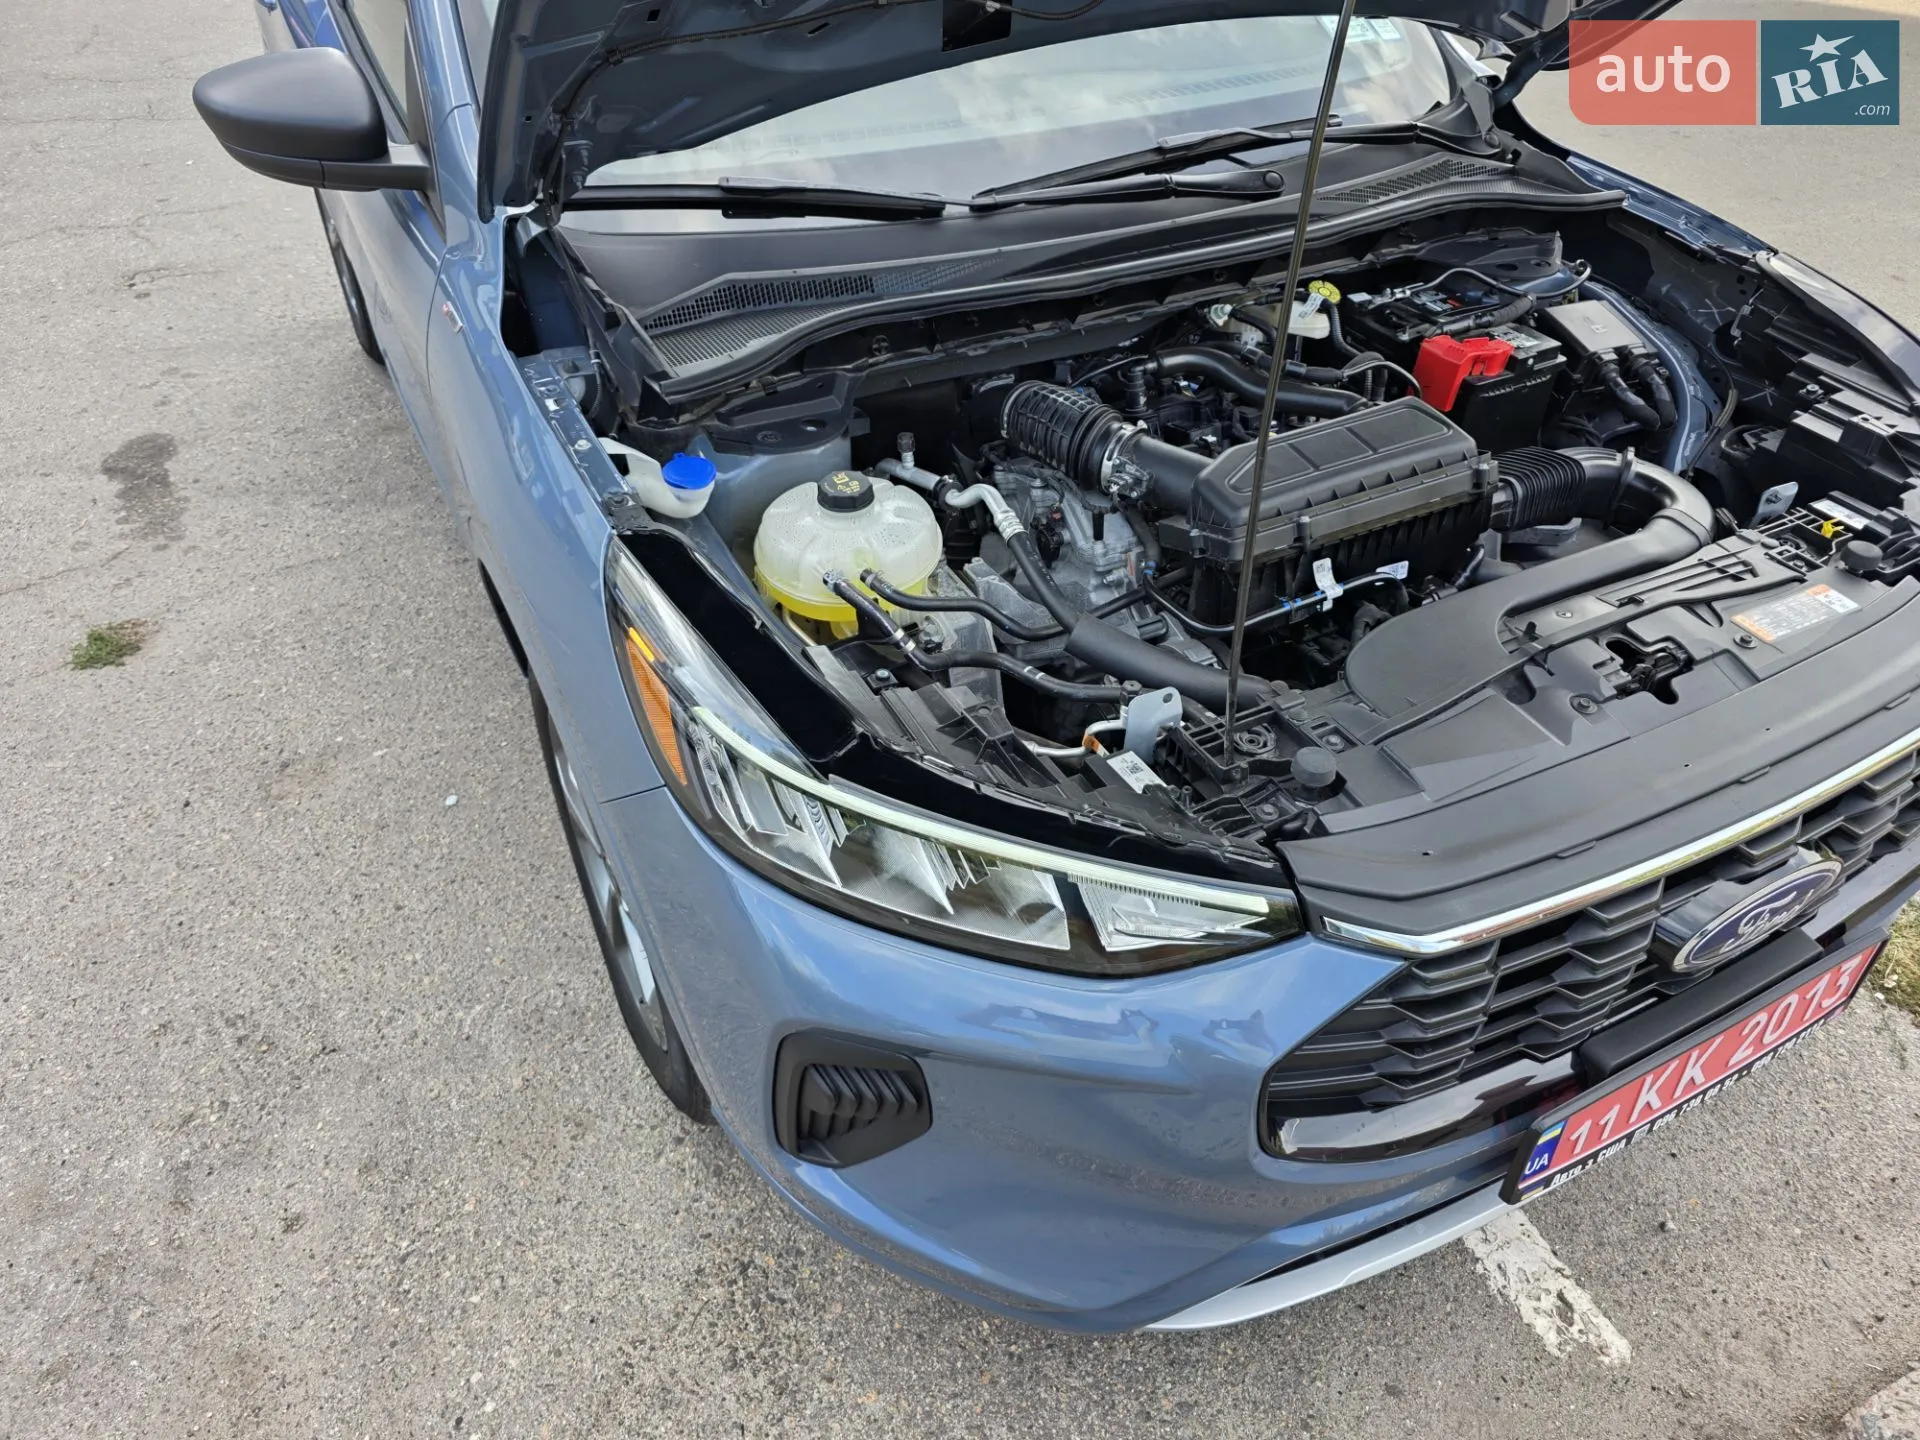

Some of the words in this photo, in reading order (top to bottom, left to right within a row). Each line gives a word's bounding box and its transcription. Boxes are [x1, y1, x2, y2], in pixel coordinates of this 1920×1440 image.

[1719, 888, 1814, 954] Ford
[1569, 1103, 1621, 1155] 11
[1628, 1034, 1724, 1124] KK
[1727, 954, 1863, 1068] 2013
[1524, 1152, 1549, 1175] UA
[1596, 1138, 1627, 1162] США
